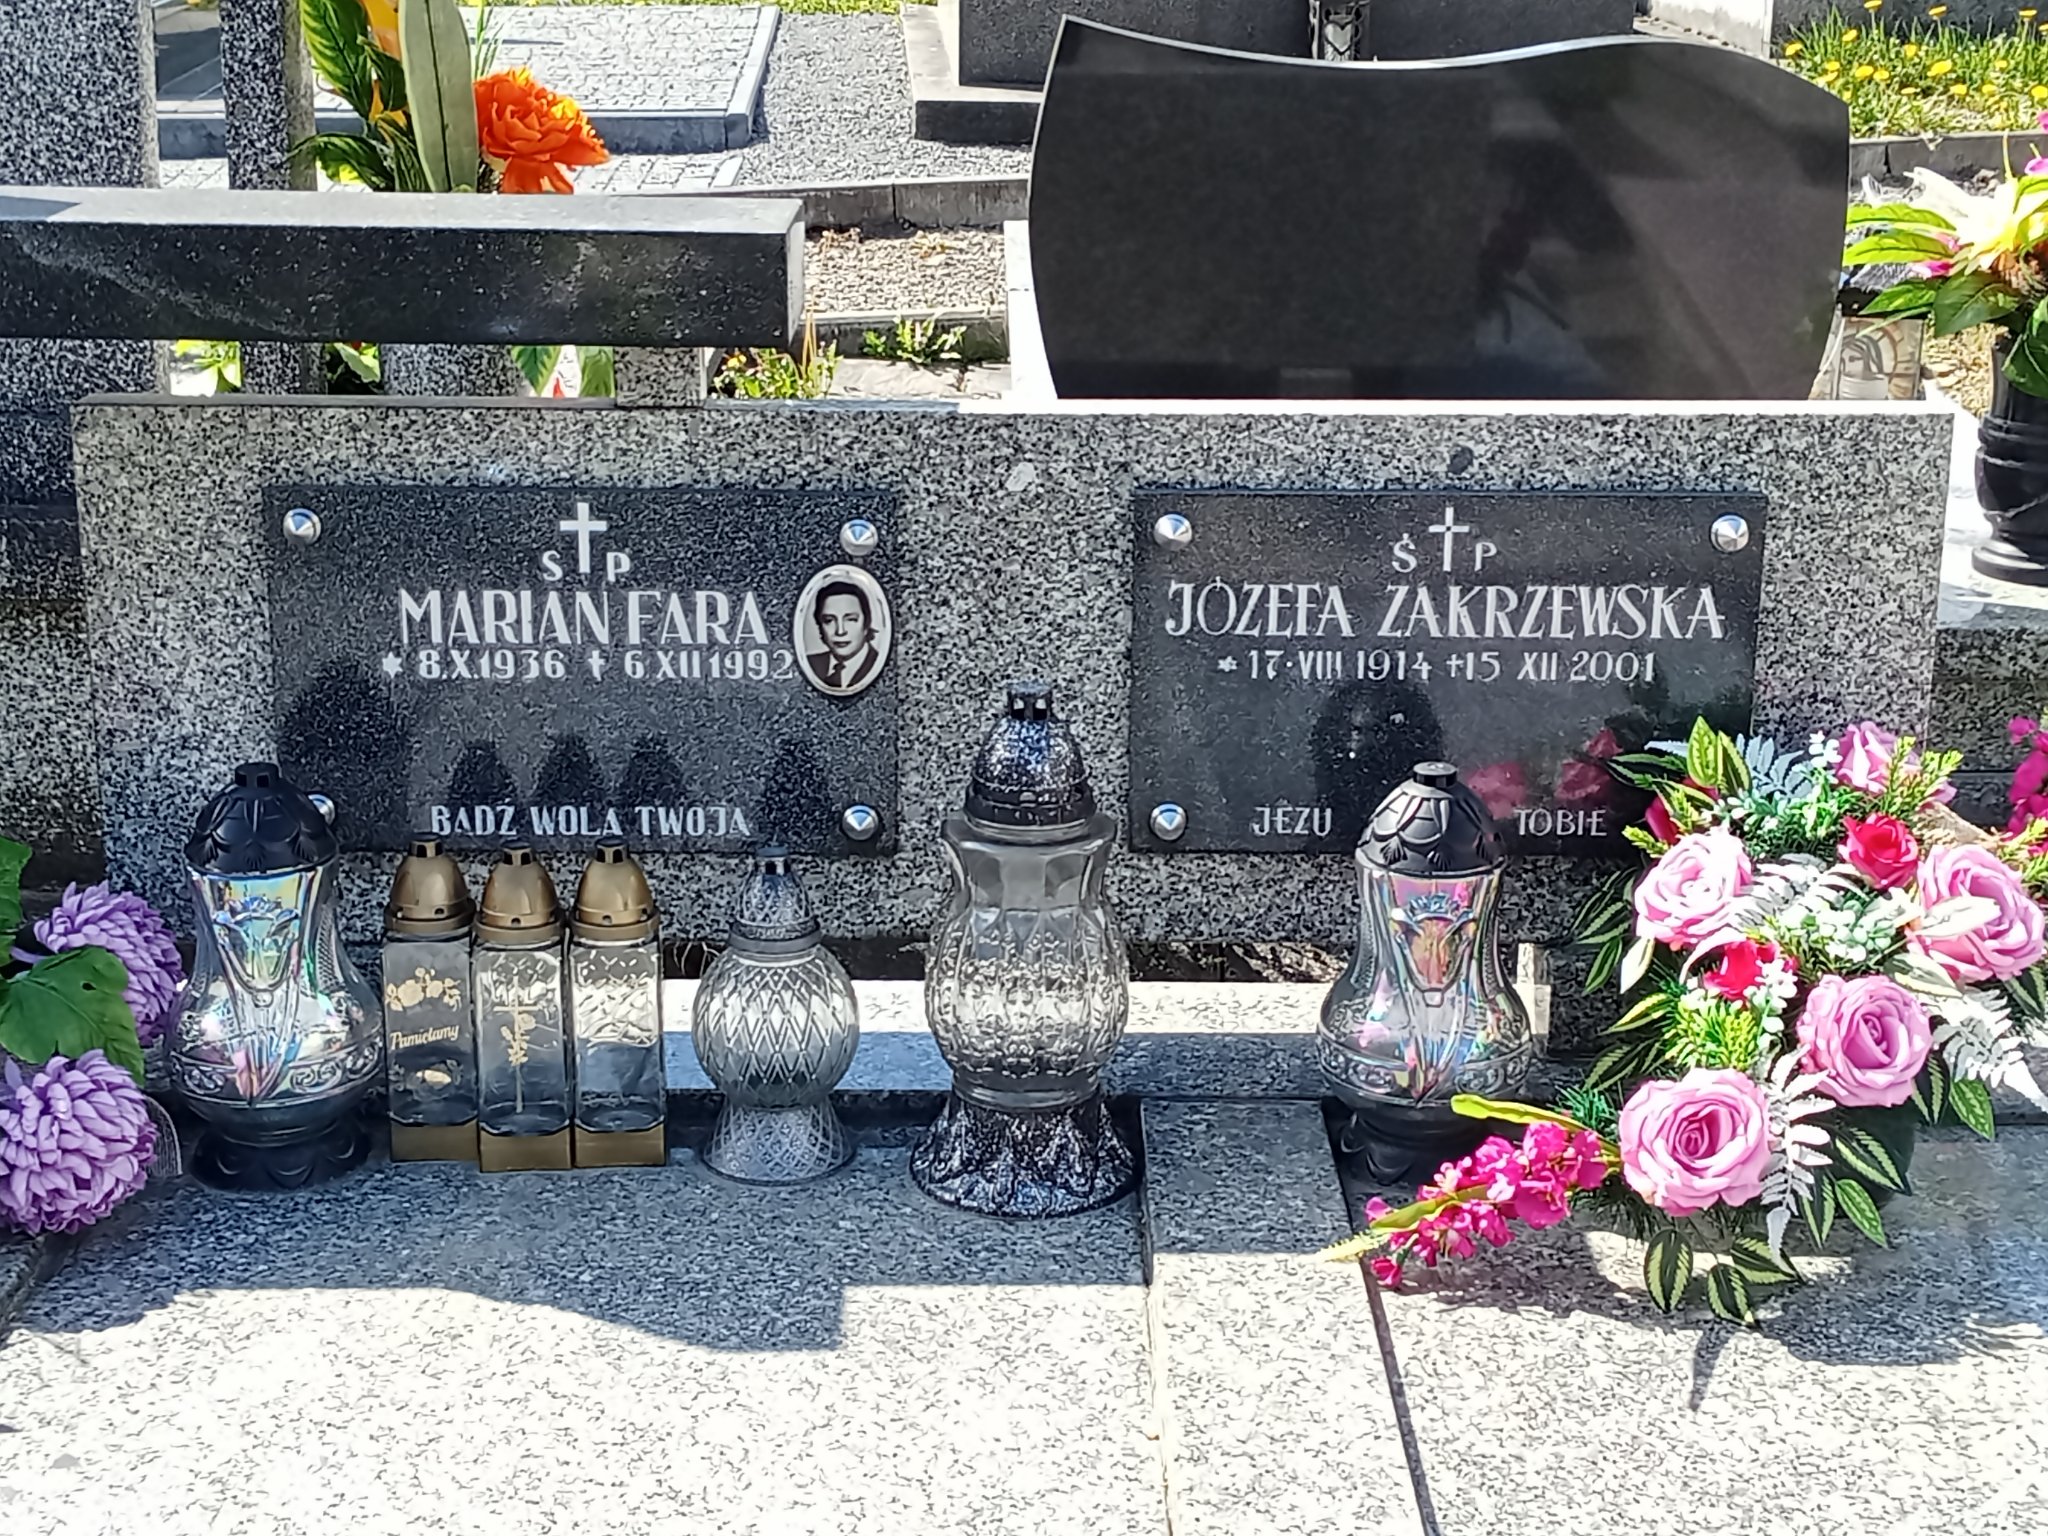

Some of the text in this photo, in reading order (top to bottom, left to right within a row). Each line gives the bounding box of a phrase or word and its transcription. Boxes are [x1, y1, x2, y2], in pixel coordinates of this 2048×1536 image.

[606, 551, 631, 582] P
[1474, 541, 1497, 571] P
[400, 588, 769, 645] MARIAN FARA
[1164, 576, 1726, 639] JÓZEFA ZAKRZEWSKA
[1356, 649, 1433, 681] 1914
[1517, 650, 1557, 681] XII
[1570, 650, 1656, 682] 2001
[530, 805, 623, 836] WOLA
[634, 806, 752, 836] TWOJA
[1513, 808, 1608, 837] TOBIE
